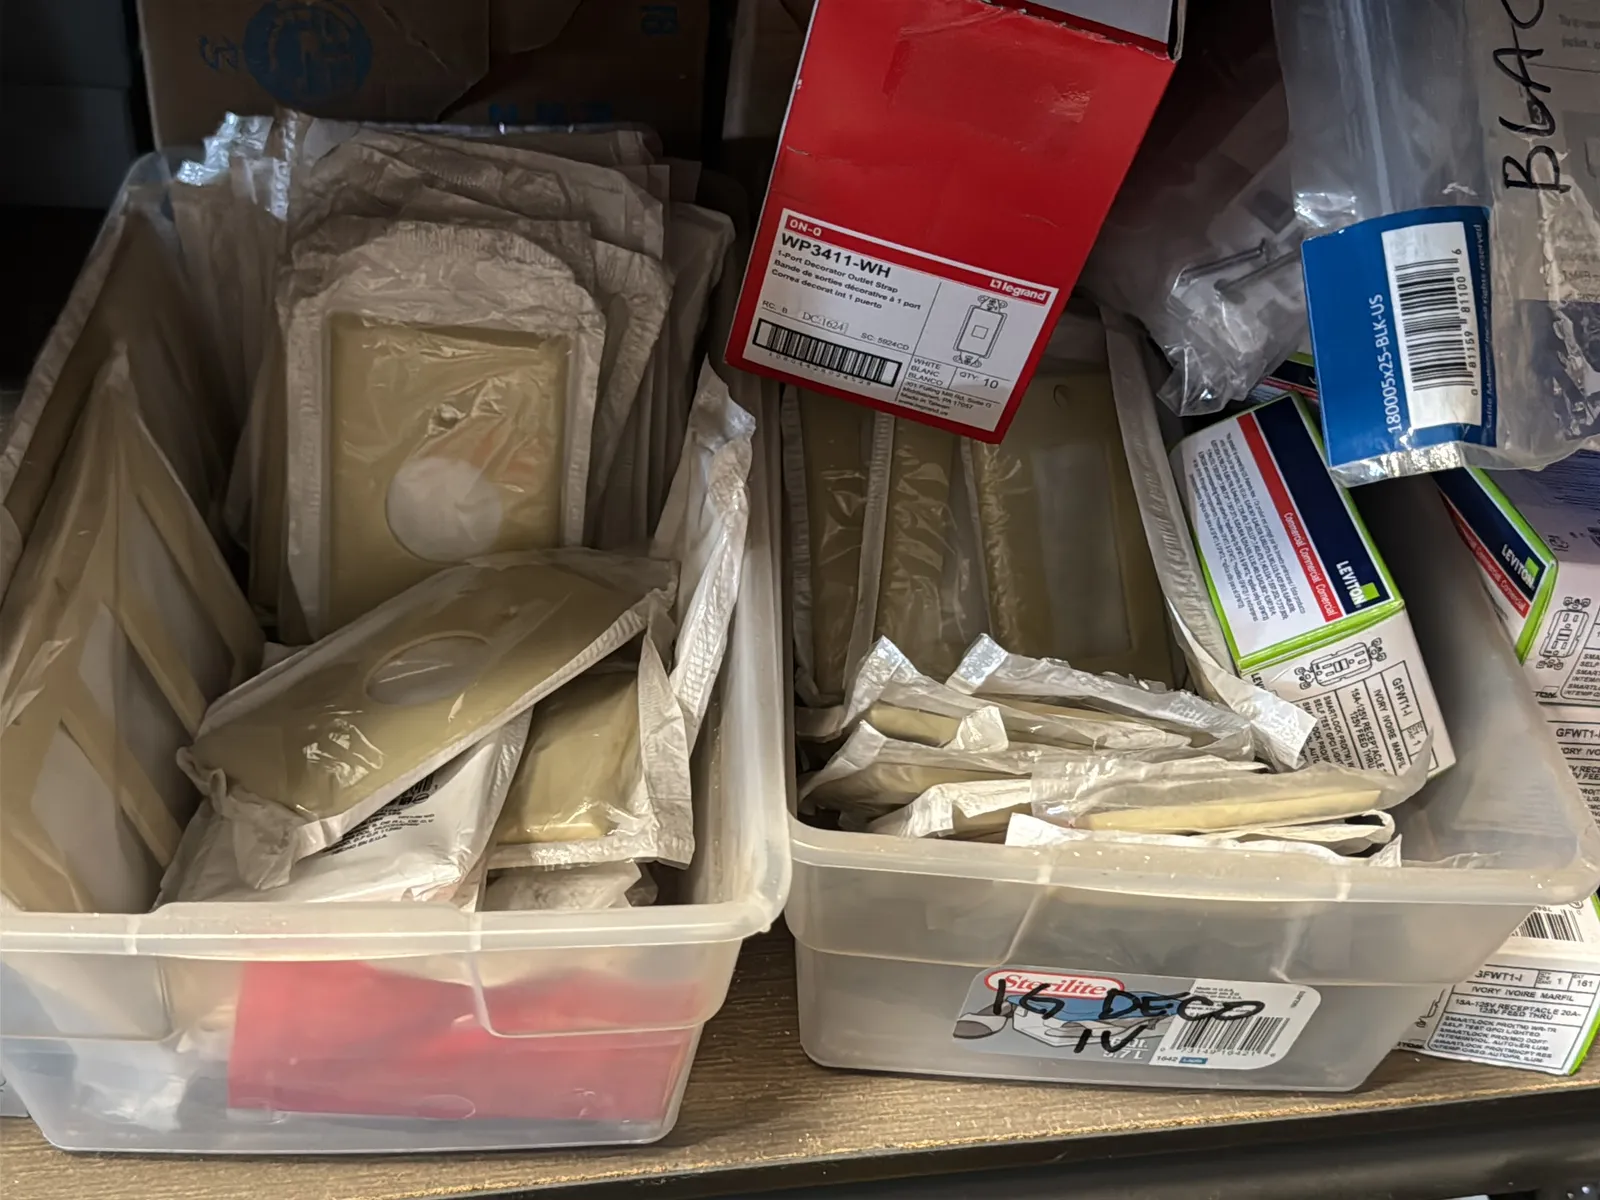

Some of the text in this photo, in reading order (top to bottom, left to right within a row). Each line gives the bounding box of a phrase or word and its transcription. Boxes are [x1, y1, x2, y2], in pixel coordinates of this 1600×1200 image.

[788, 218, 823, 237] ON-Q
[778, 232, 892, 279] WP3411-WH
[776, 250, 898, 294] 1-Port Decorator Outlet Strap
[770, 268, 800, 283] Correa
[800, 278, 834, 294] decorat
[834, 288, 846, 298] int
[853, 295, 882, 311] puerto
[773, 259, 800, 273] Bande
[801, 268, 813, 277] de
[814, 272, 843, 286] sorties
[844, 281, 888, 301] décorative
[902, 300, 921, 311] port
[1001, 279, 1047, 304] legrand
[1455, 275, 1470, 313] 81100
[876, 336, 909, 351] 5924CD
[1463, 329, 1478, 368] 81159
[910, 364, 940, 377] BLANC
[913, 357, 941, 370] WHITE
[1368, 293, 1402, 433] 180005x25-BLK-US
[907, 372, 943, 386] BLANCO
[982, 377, 999, 389] 10
[1470, 388, 1478, 396] 0
[1282, 511, 1336, 617] Commercial Commercial Comercial
[1335, 560, 1367, 605] LEVITON
[1312, 698, 1325, 715] SELF
[1390, 676, 1413, 717] GFWT1-I
[1318, 715, 1331, 732] TEST
[1322, 694, 1342, 735] SMARTLOCK
[1324, 731, 1336, 748] GFCI
[1349, 710, 1375, 769] 125V FEED THRU
[1350, 687, 1385, 769] 15A-125V RECEPTACLE
[1373, 688, 1407, 769] IVORY IVOIRE MARFIL
[1560, 746, 1582, 755] ORY
[1471, 985, 1573, 1002] IVORY IVOIRE MARFIL
[1576, 979, 1592, 987] 161
[1098, 987, 1266, 1020] DECO
[1497, 1002, 1558, 1015] RECEPTACLE
[1500, 1008, 1525, 1017] FEED
[1528, 1011, 1553, 1020] THRU
